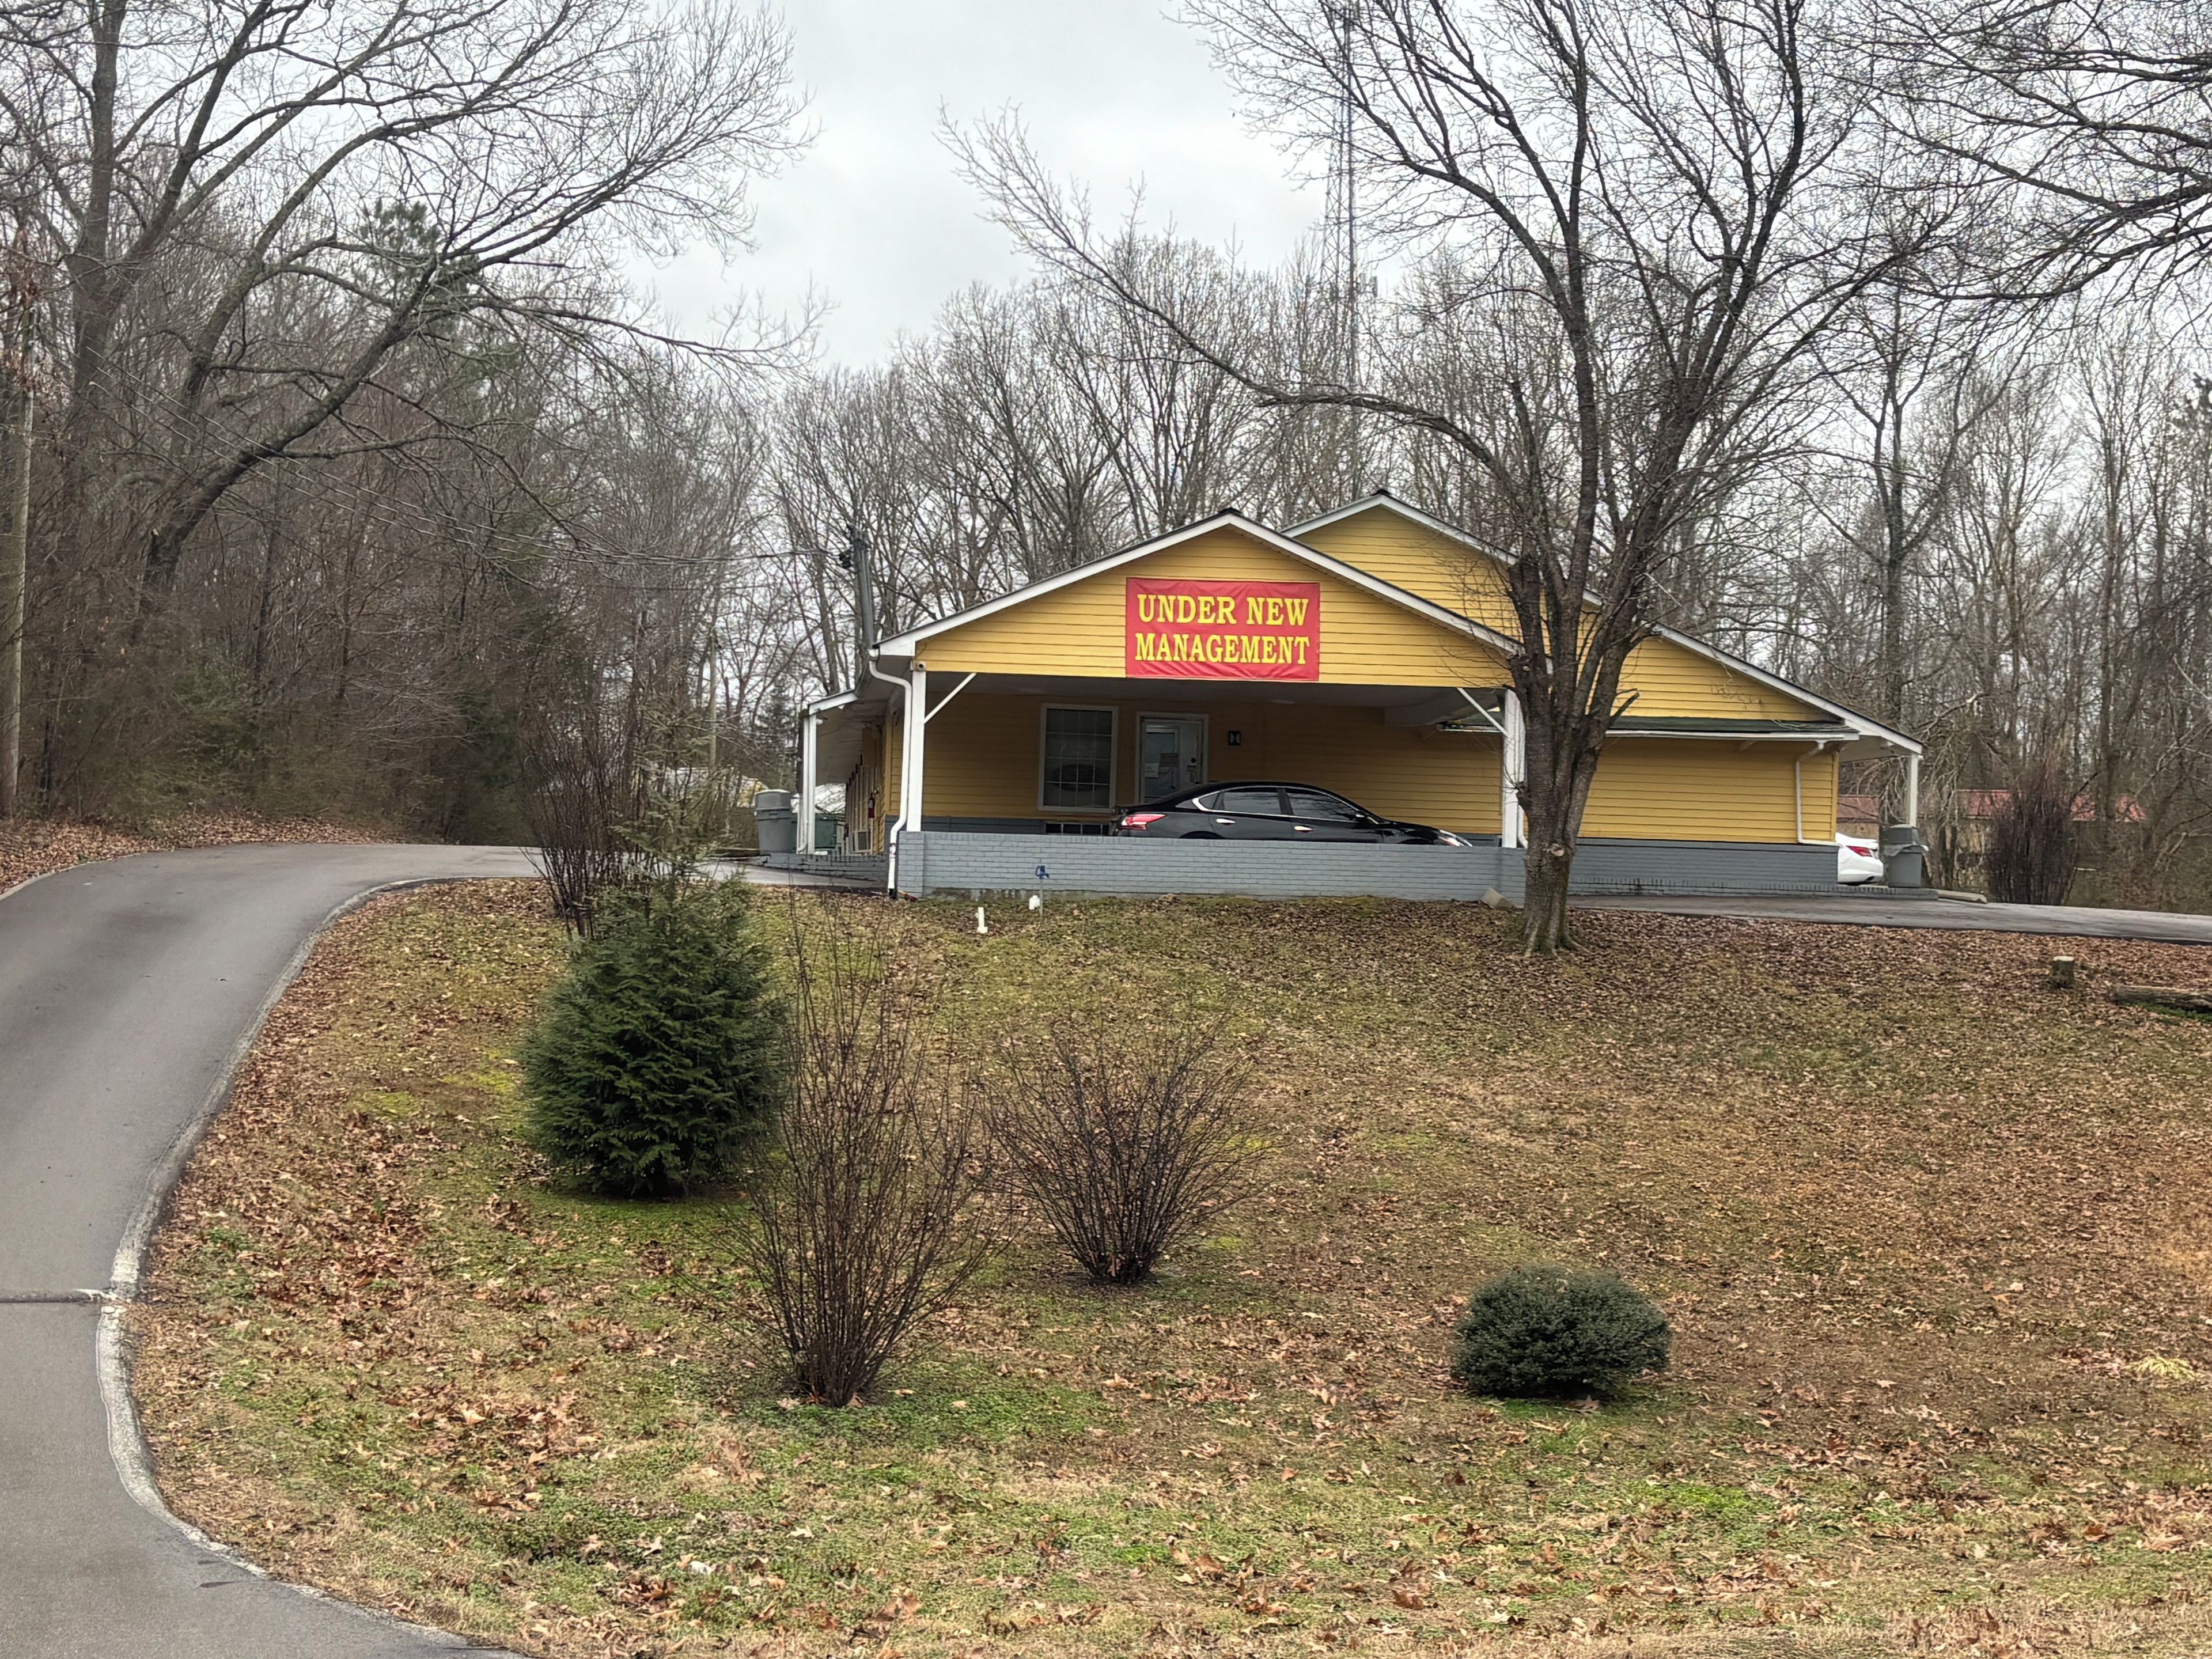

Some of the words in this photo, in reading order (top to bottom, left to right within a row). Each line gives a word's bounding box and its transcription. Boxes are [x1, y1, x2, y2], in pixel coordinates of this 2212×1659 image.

[1137, 594, 1237, 624] UNDER
[1247, 597, 1309, 626] NEW
[1135, 632, 1309, 664] MANAGEMENT
